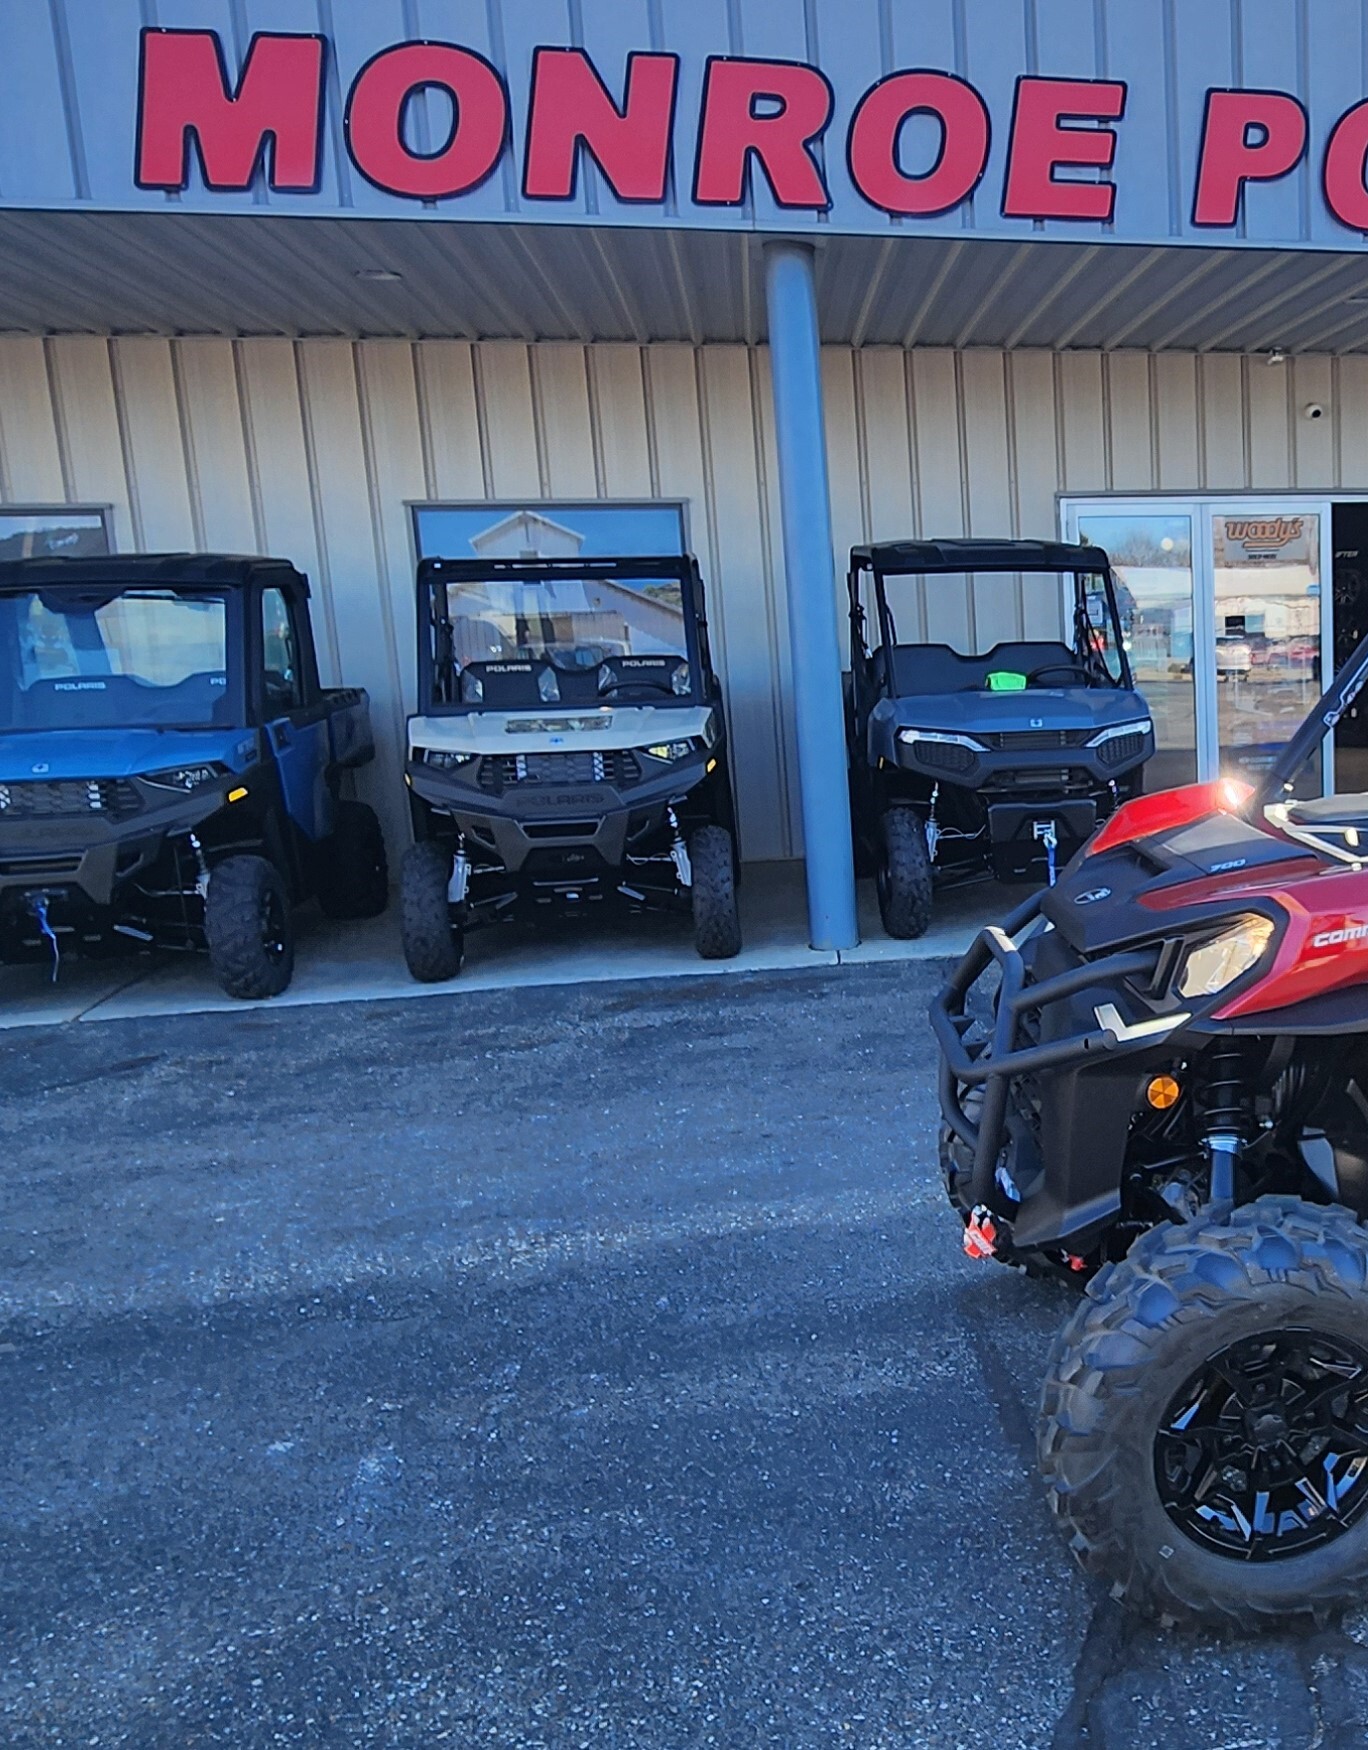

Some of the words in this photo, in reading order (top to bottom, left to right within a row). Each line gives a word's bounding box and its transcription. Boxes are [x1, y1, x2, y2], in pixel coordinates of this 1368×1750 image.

[135, 27, 1128, 224] MONROE
[1225, 518, 1303, 548] woody's
[486, 665, 532, 673] POLARIS
[54, 682, 106, 691] POLARIS
[1210, 859, 1246, 872] 700
